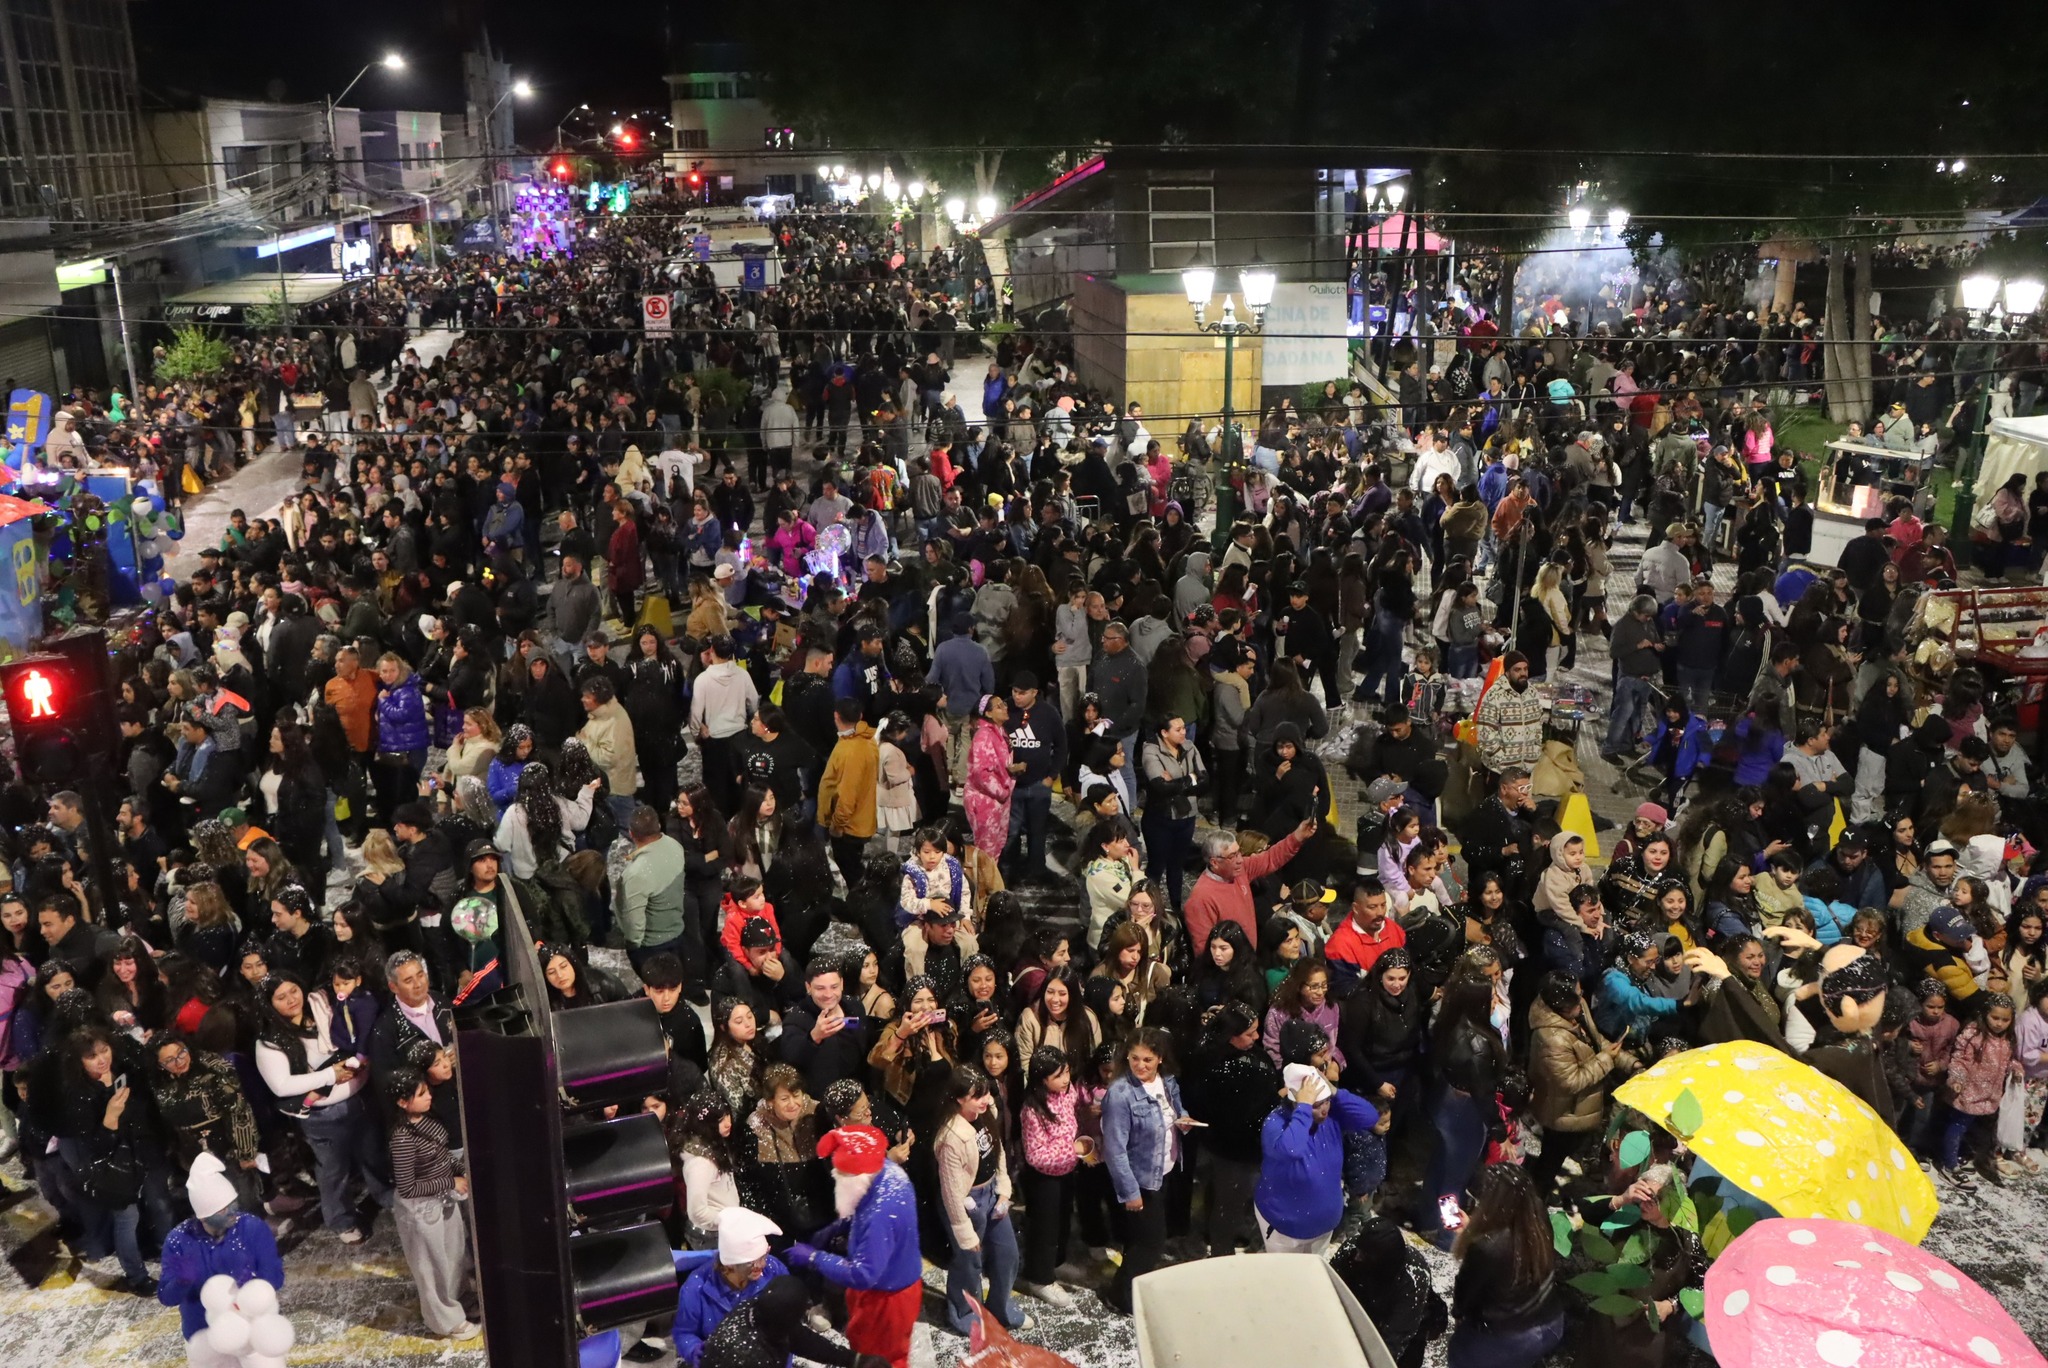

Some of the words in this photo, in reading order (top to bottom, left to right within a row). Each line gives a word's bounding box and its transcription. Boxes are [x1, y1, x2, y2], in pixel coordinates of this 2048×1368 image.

[164, 304, 194, 317] Open
[197, 304, 232, 318] Coffee
[1310, 305, 1330, 322] DE
[10, 393, 42, 443] 1
[671, 464, 681, 477] 9
